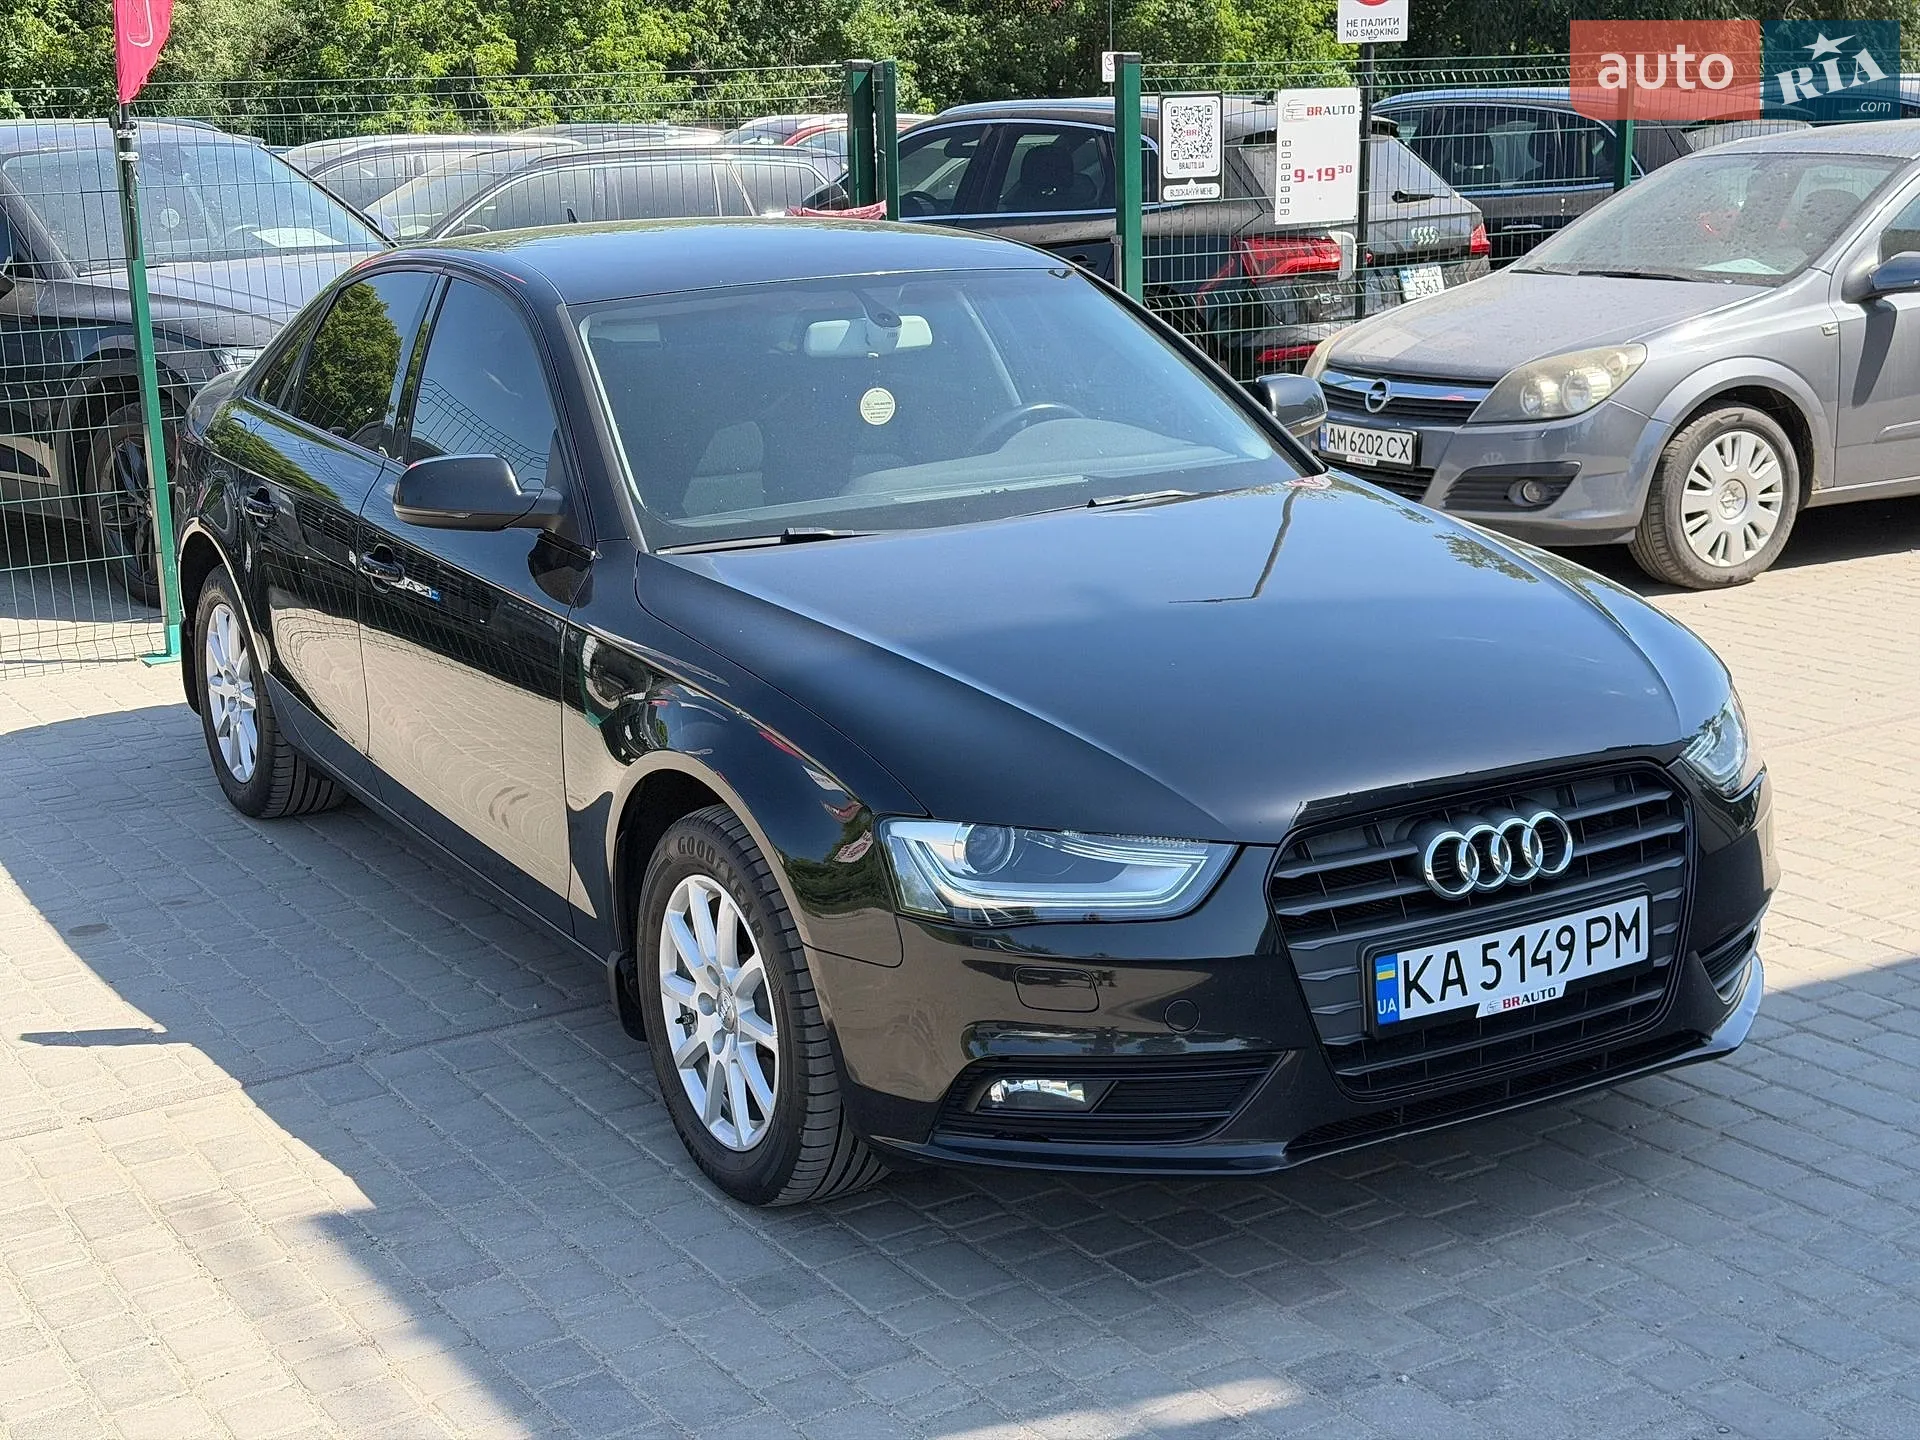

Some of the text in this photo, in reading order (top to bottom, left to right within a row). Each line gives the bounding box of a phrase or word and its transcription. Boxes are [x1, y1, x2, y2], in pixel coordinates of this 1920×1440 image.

[1346, 17, 1400, 28] НЕ ПАЛИТИ
[1346, 27, 1400, 37] NO SMOKING
[1306, 104, 1356, 117] BRAUTO
[1327, 427, 1410, 461] AM 6202 CX
[1402, 905, 1641, 1009] KA 5149 PM
[1377, 998, 1398, 1015] UA
[1502, 986, 1557, 1010] BRAUTO
